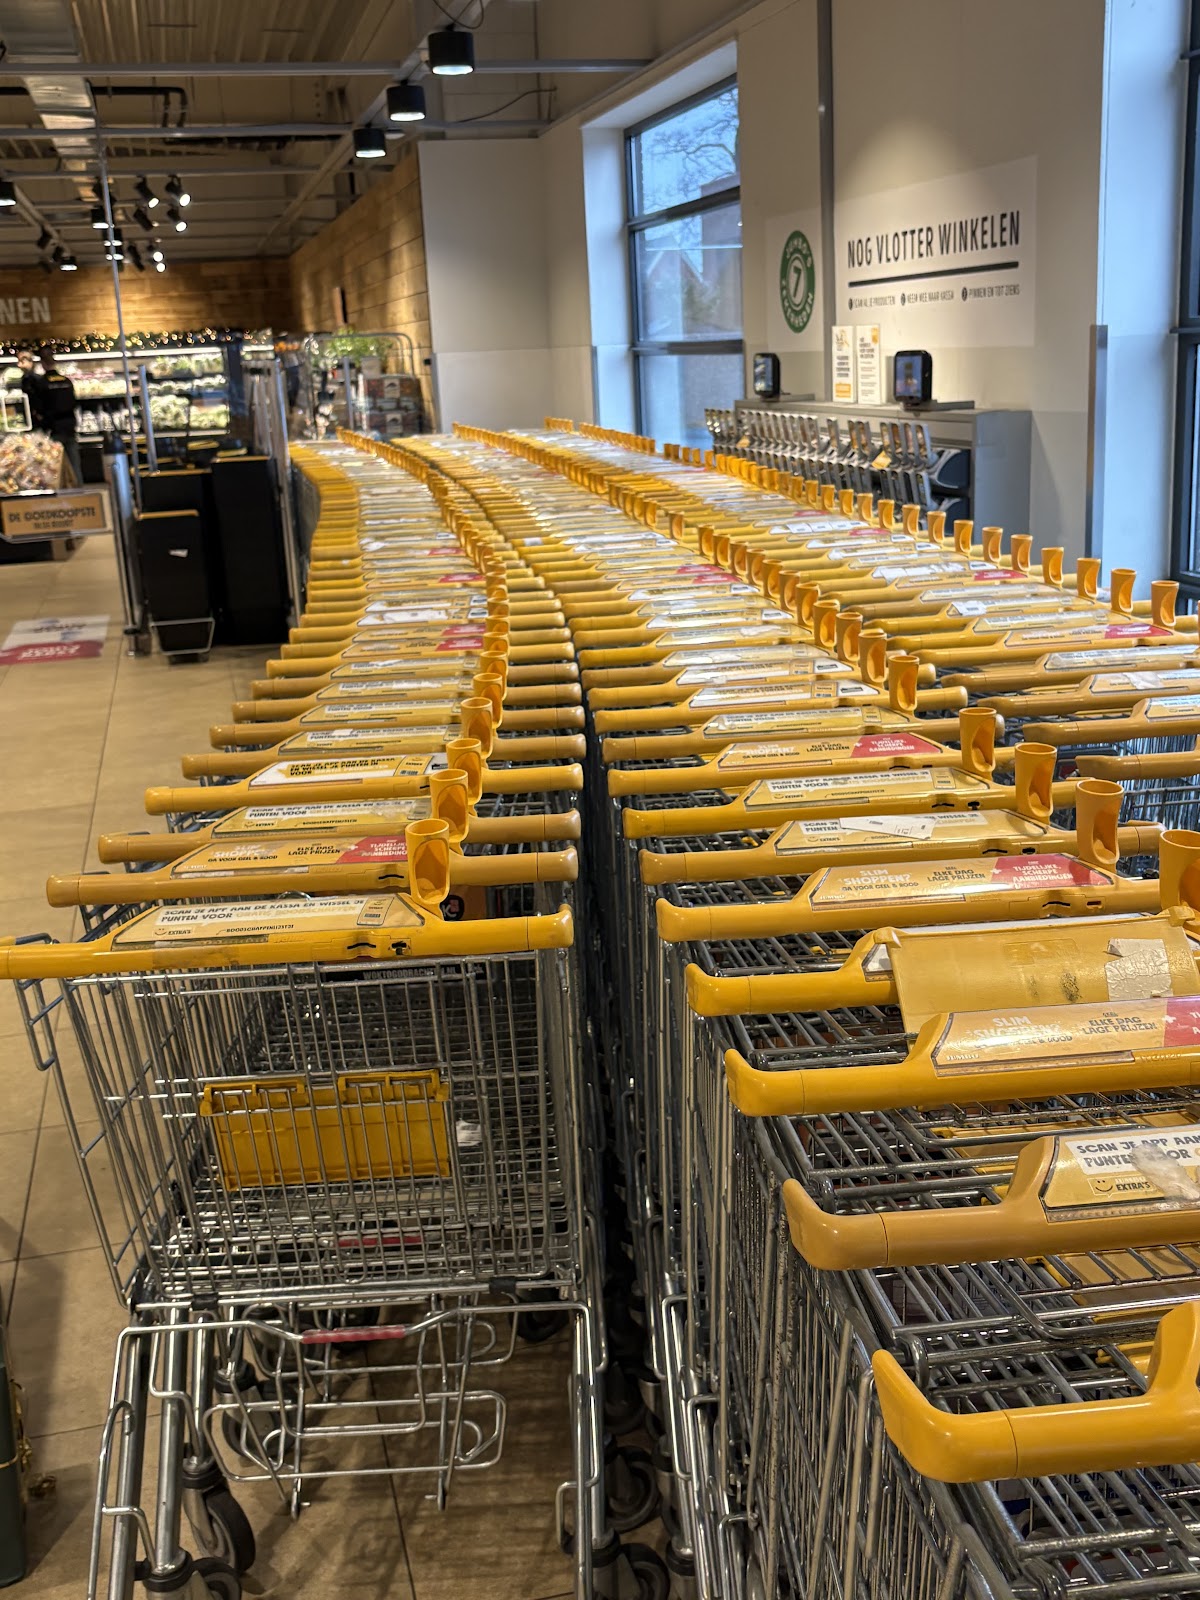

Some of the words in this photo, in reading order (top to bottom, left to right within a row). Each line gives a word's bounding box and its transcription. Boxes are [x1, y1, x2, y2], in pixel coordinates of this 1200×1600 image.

[847, 237, 873, 269] NOG
[876, 226, 934, 264] VLOTTER
[938, 210, 1020, 256] WINKELEN
[793, 265, 802, 298] 7
[843, 873, 911, 885] SHOPPEN?
[1012, 873, 1074, 882] AANBIEDINGEN
[161, 914, 199, 922] PUNTEN
[992, 1016, 1032, 1027] SLIM
[1088, 1018, 1114, 1026] ELKE
[1115, 1016, 1142, 1024] DAG
[1082, 1026, 1112, 1035] LAGE
[1113, 1022, 1158, 1033] PRIJZEN
[1076, 1142, 1117, 1154] SCAN
[1119, 1140, 1136, 1150] JE
[1175, 1134, 1200, 1145] AAN
[1083, 1153, 1134, 1167] PUNTE
[1114, 1176, 1146, 1184] JUMBO
[1116, 1181, 1151, 1191] EXTRA'S
